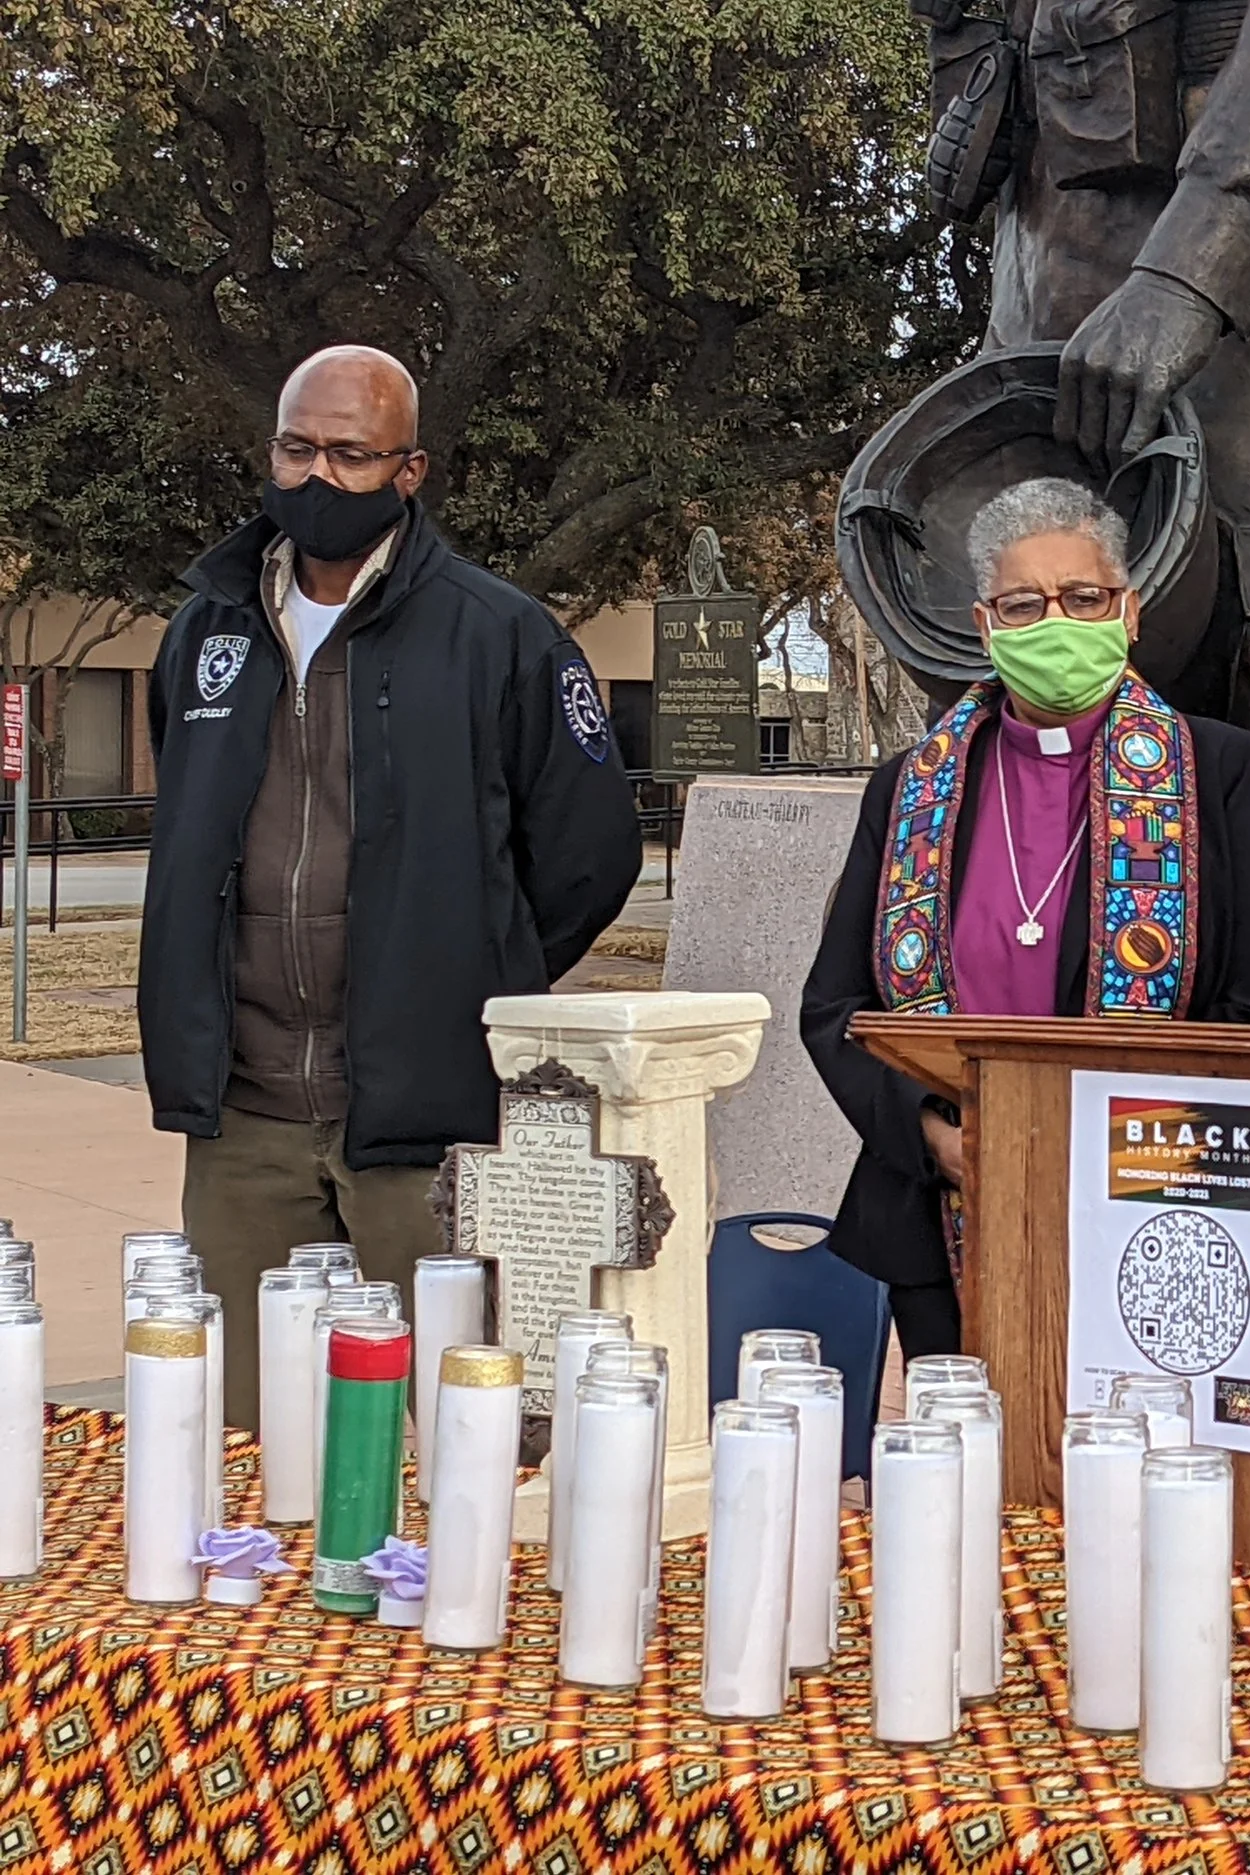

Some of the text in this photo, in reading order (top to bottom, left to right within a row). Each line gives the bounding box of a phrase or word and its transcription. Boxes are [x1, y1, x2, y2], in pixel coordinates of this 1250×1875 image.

[662, 620, 745, 639] GOLD STAR
[679, 650, 727, 669] MEMORIAL
[513, 1129, 586, 1149] Our Father
[1126, 1119, 1250, 1150] BLACK
[1126, 1145, 1250, 1164] HISTORY MONTH
[1117, 1168, 1168, 1181] HONORING
[1170, 1171, 1201, 1184] BLACK
[1202, 1174, 1228, 1187] LIVES
[524, 1339, 556, 1364] Ame
